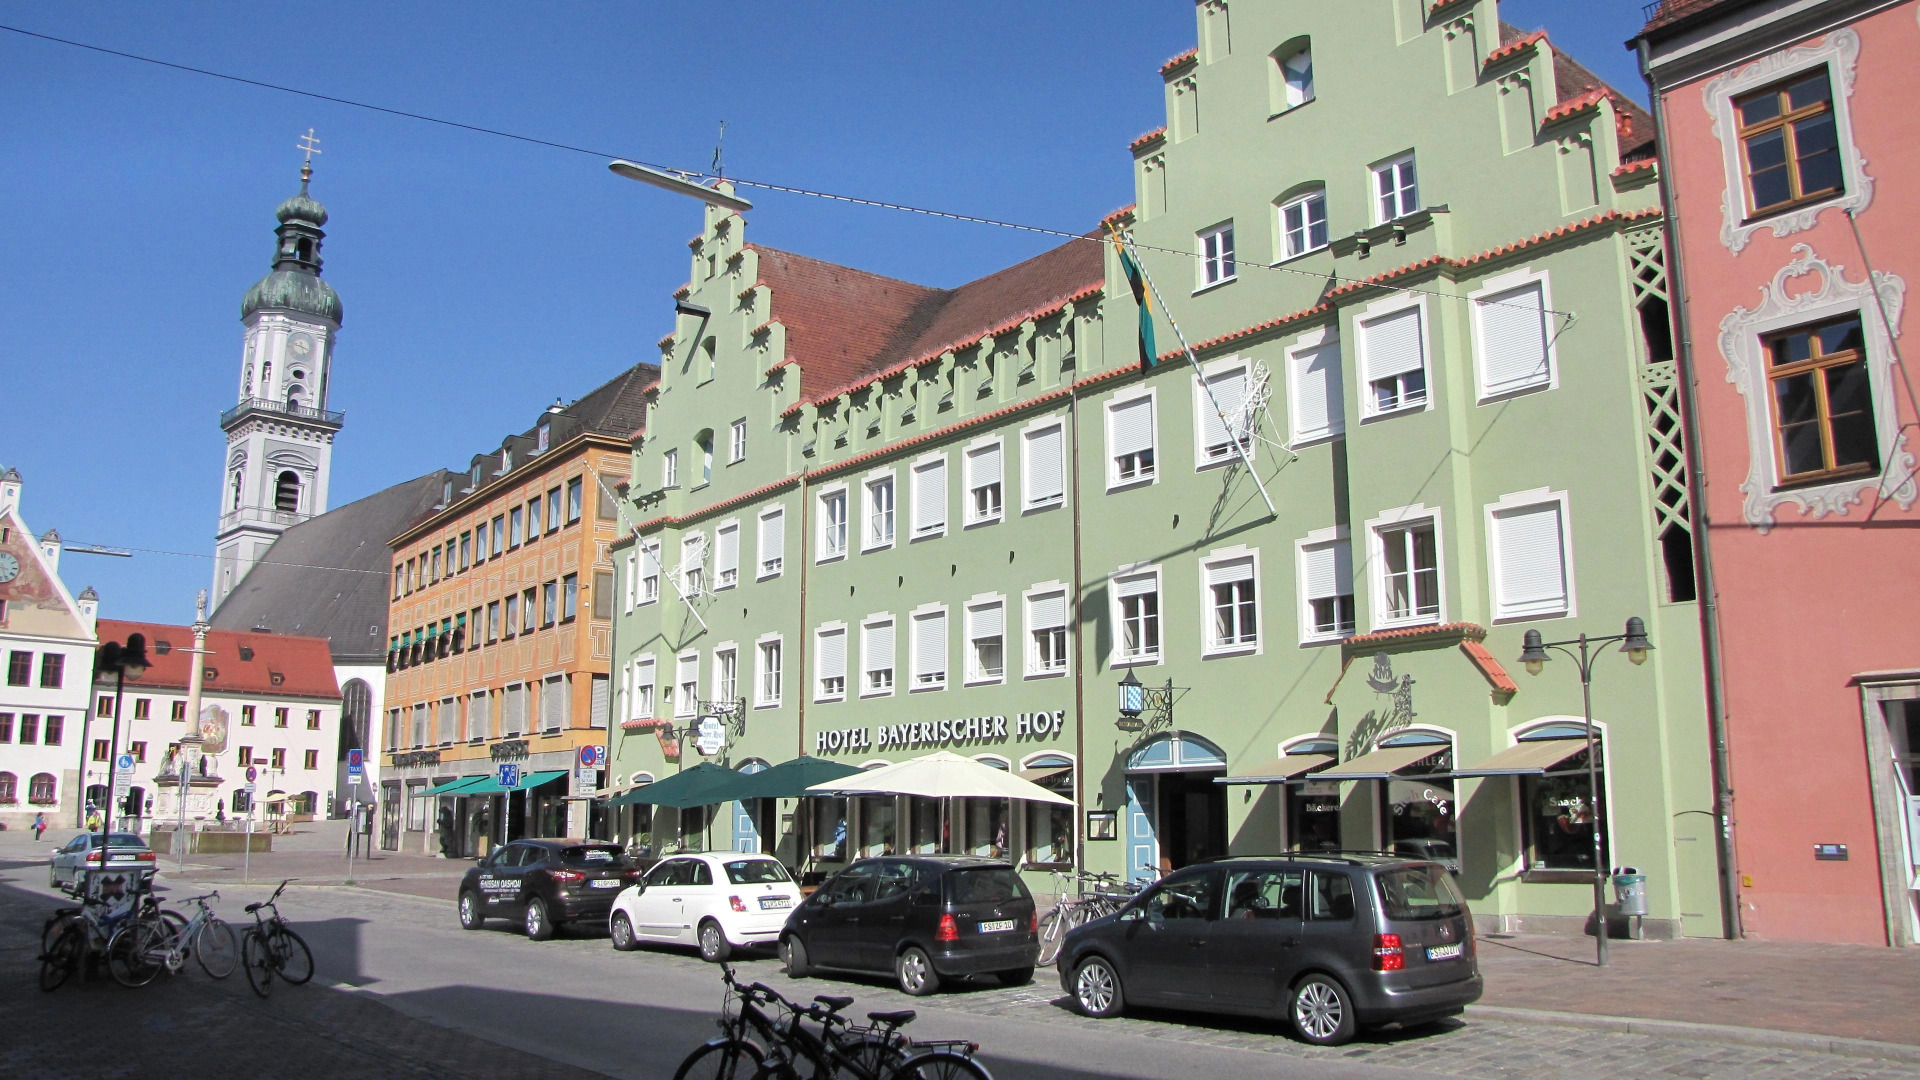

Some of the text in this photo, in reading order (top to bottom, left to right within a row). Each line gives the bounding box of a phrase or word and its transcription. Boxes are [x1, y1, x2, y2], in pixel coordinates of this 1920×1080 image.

[816, 709, 1064, 750] HOTEL BAYERISCHER HOF
[1306, 803, 1341, 812] Bäckere
[1423, 788, 1448, 816] Cafe
[983, 923, 992, 931] FS
[995, 922, 1003, 930] ZF
